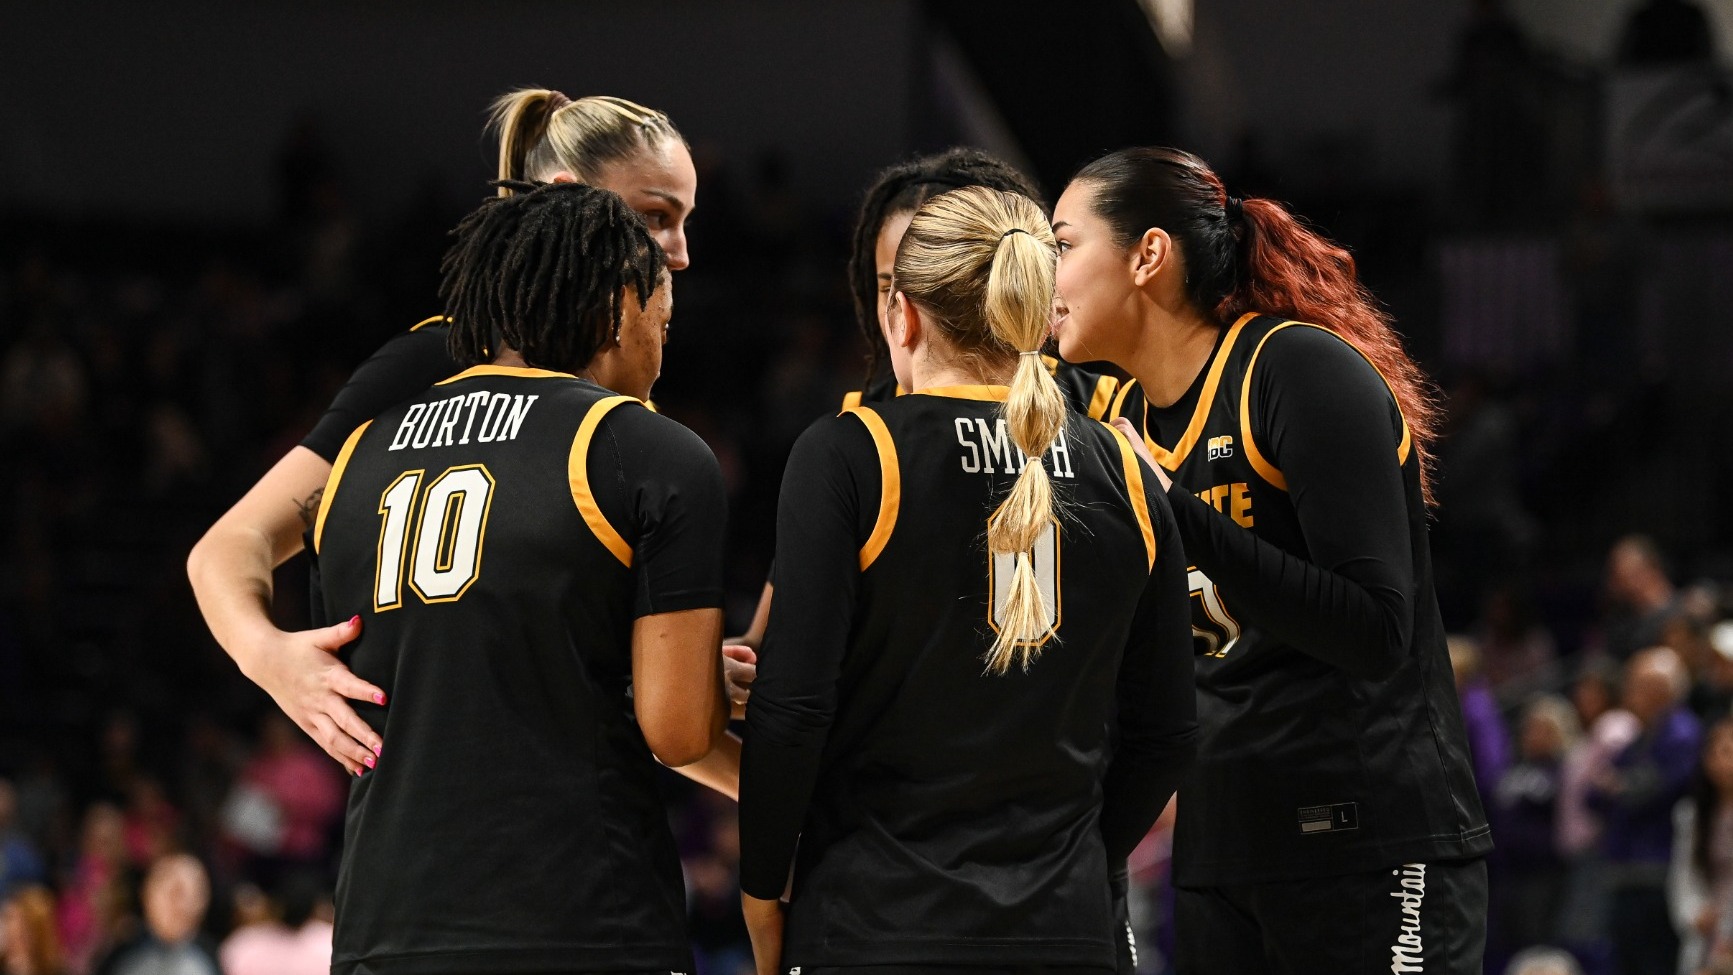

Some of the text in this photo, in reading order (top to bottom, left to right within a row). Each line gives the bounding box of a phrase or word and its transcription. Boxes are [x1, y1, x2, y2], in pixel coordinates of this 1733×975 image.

[388, 390, 539, 451] BURTON
[954, 417, 1075, 479] SMH
[374, 463, 496, 613] 10
[1341, 810, 1349, 823] L
